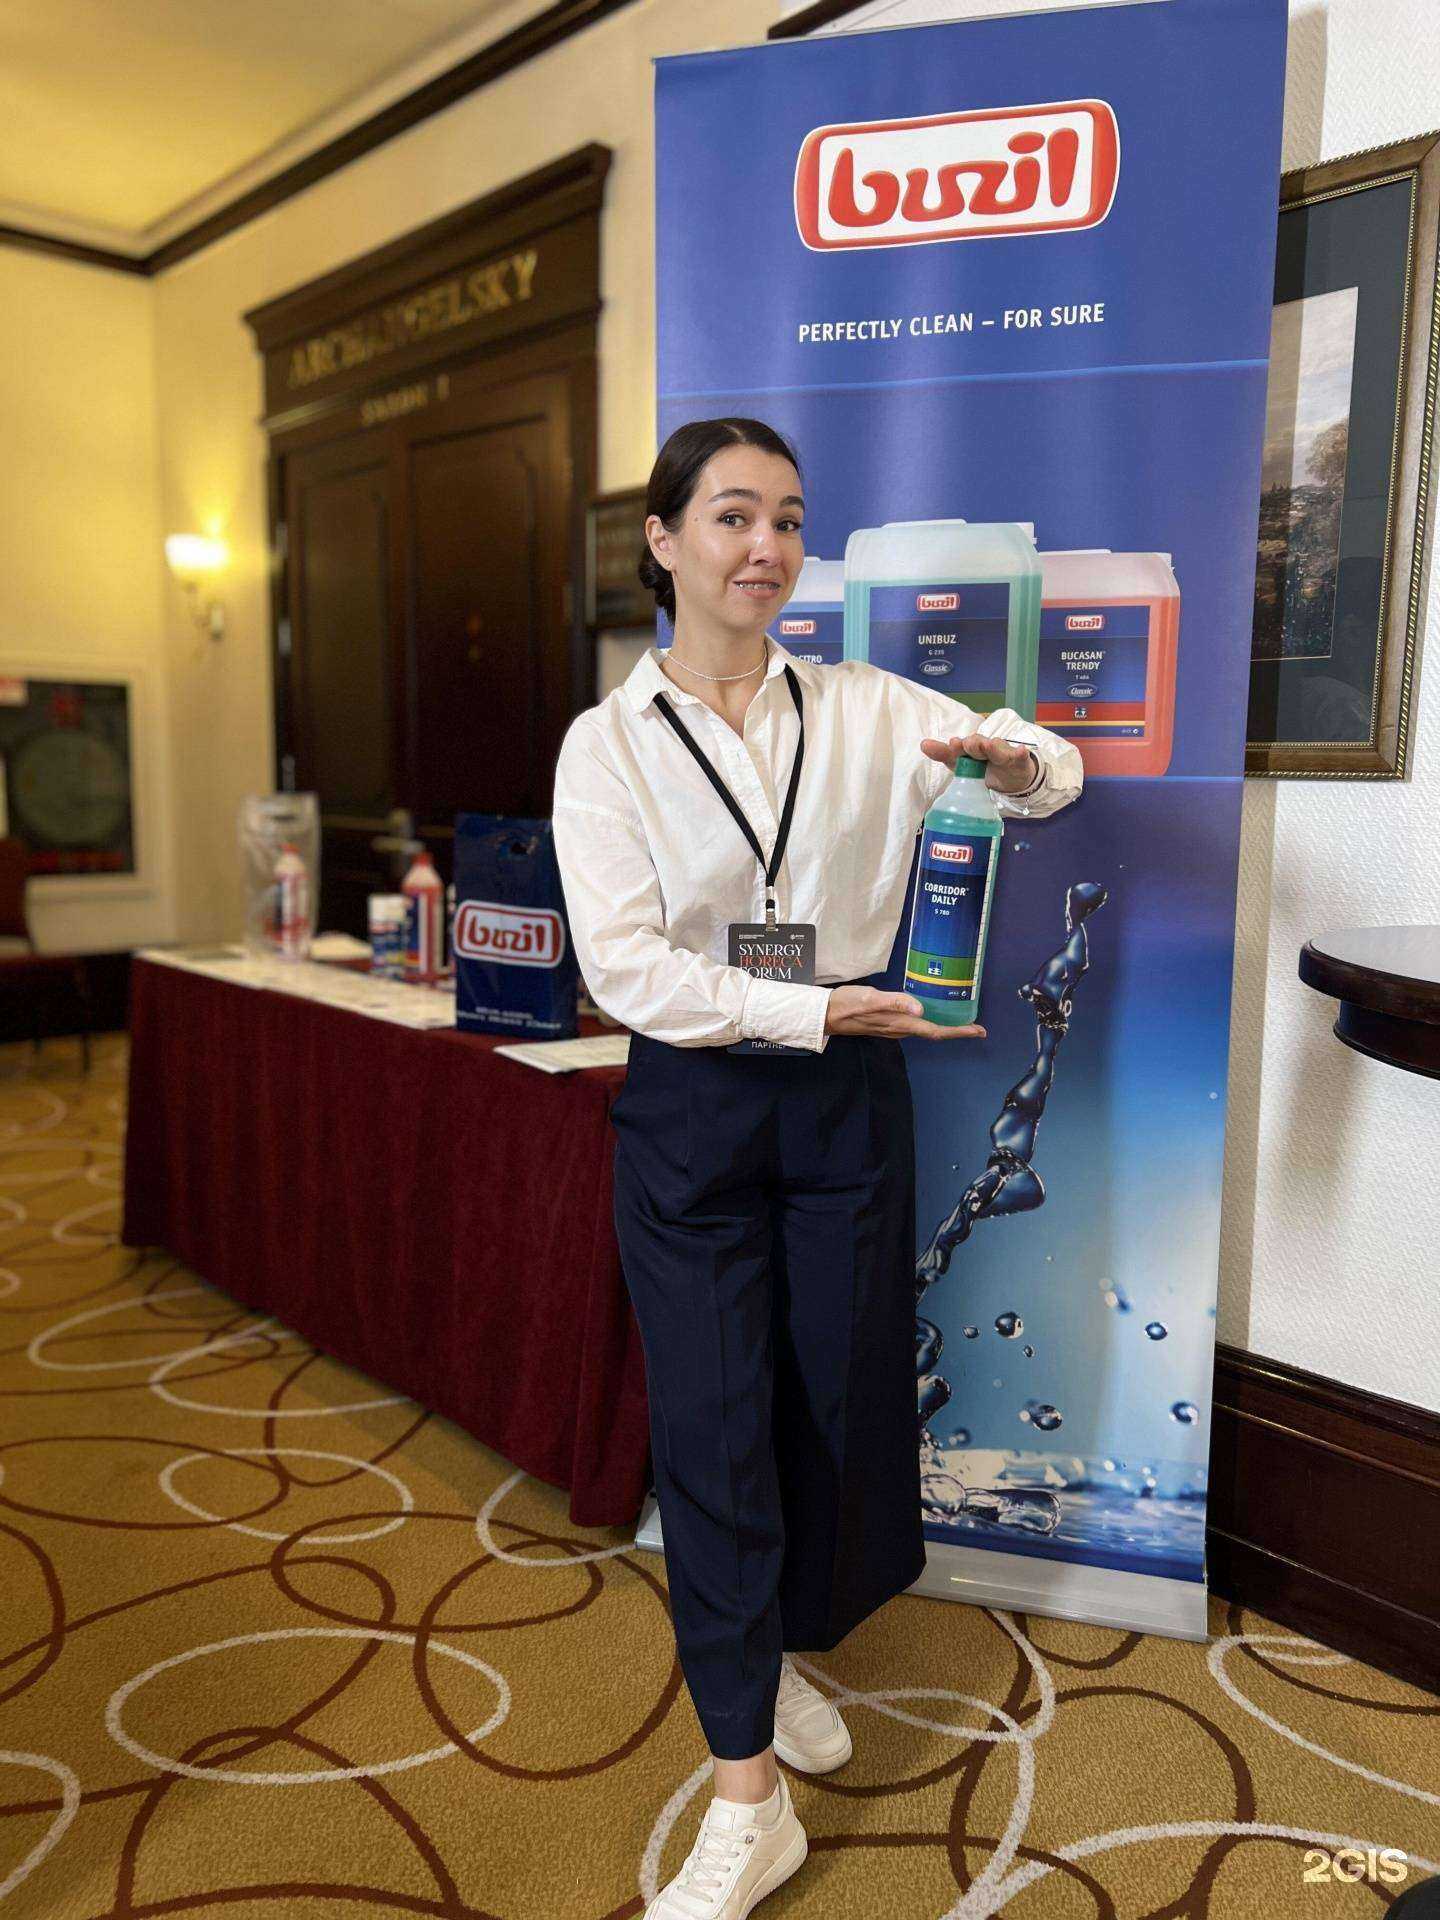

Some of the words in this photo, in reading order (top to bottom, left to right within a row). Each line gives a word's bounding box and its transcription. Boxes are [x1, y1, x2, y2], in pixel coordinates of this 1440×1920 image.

[827, 127, 1079, 228] buzil
[287, 249, 538, 391] ARCHGELSKY
[798, 319, 902, 343] PERFECTLY
[910, 312, 974, 336] CLEAN
[1003, 308, 1042, 330] FOR
[1050, 303, 1106, 326] SURE
[918, 634, 957, 645] UNIBUZ
[1061, 651, 1103, 660] BUCASAN
[923, 663, 949, 673] Classic
[1066, 661, 1101, 670] TRENDY
[1070, 687, 1094, 696] Classic
[924, 882, 967, 896] CORRIDOR
[931, 894, 958, 906] DAILY
[467, 914, 546, 953] buzil
[738, 943, 804, 956] SYNERGY
[739, 955, 804, 968] HORECA
[751, 1041, 785, 1049] ПАРТНЕ
